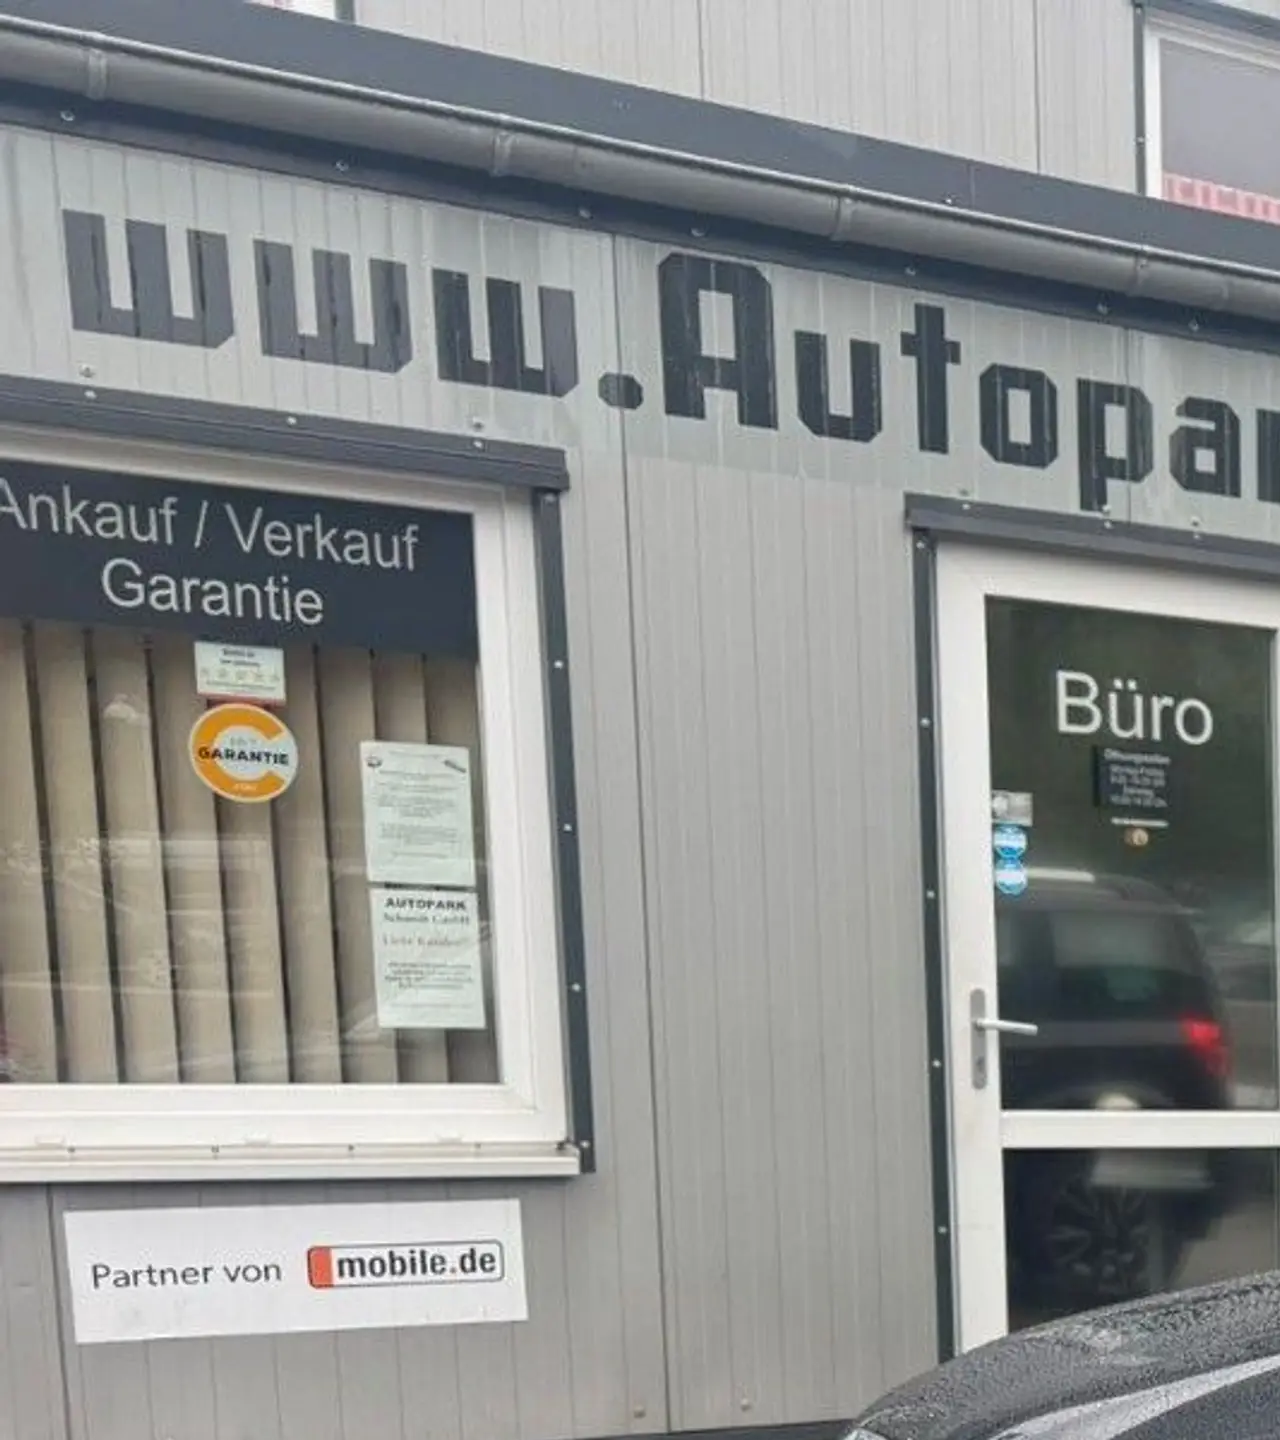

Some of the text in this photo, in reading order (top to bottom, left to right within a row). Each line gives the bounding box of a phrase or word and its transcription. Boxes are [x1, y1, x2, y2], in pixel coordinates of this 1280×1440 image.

[0, 477, 178, 546] Ankauf
[226, 501, 420, 571] Verkauf
[102, 558, 324, 625] Garantie
[1056, 670, 1213, 745] Büro
[198, 746, 289, 765] GARANTIE
[92, 1247, 497, 1289] Partner von mobile.de
